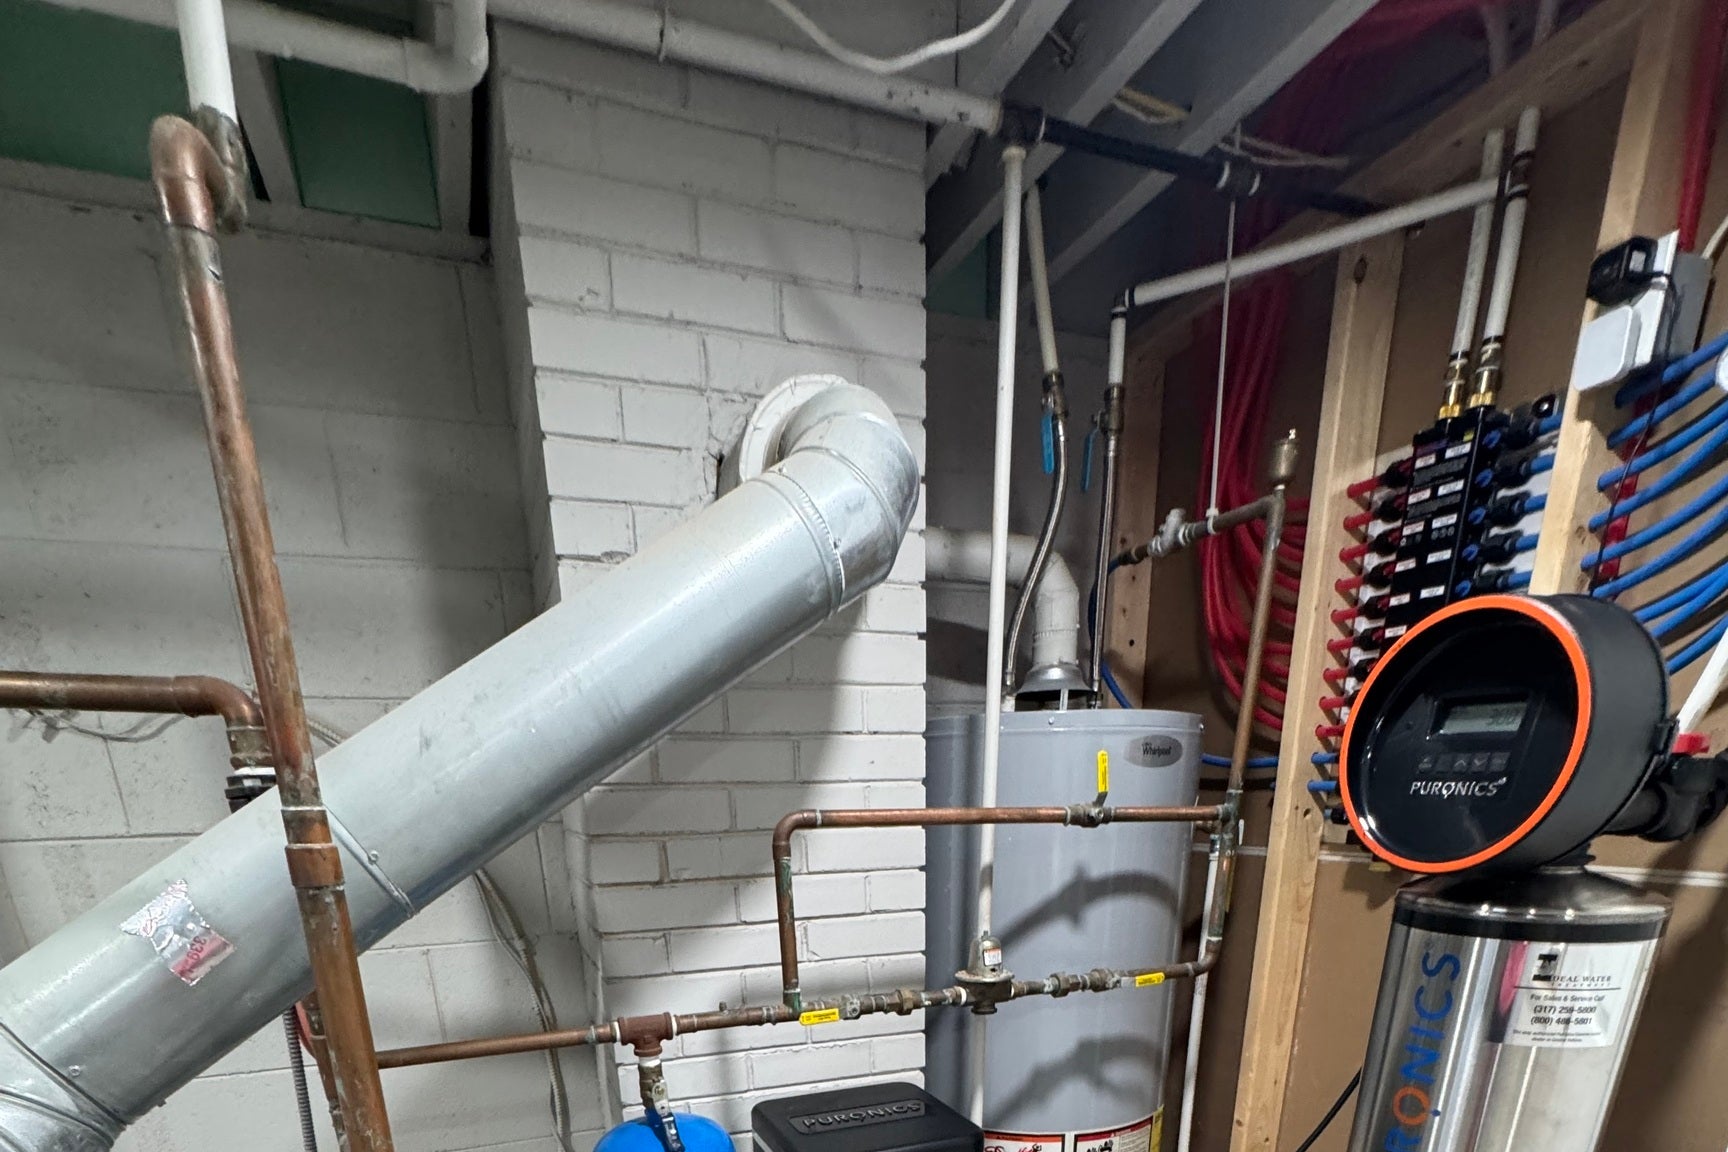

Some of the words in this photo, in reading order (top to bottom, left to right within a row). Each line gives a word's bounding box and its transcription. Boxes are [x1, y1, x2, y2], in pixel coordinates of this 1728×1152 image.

[1409, 779, 1505, 799] PURONICS
[1533, 1005, 1557, 1015] (317)
[802, 1103, 920, 1128] PURONICS
